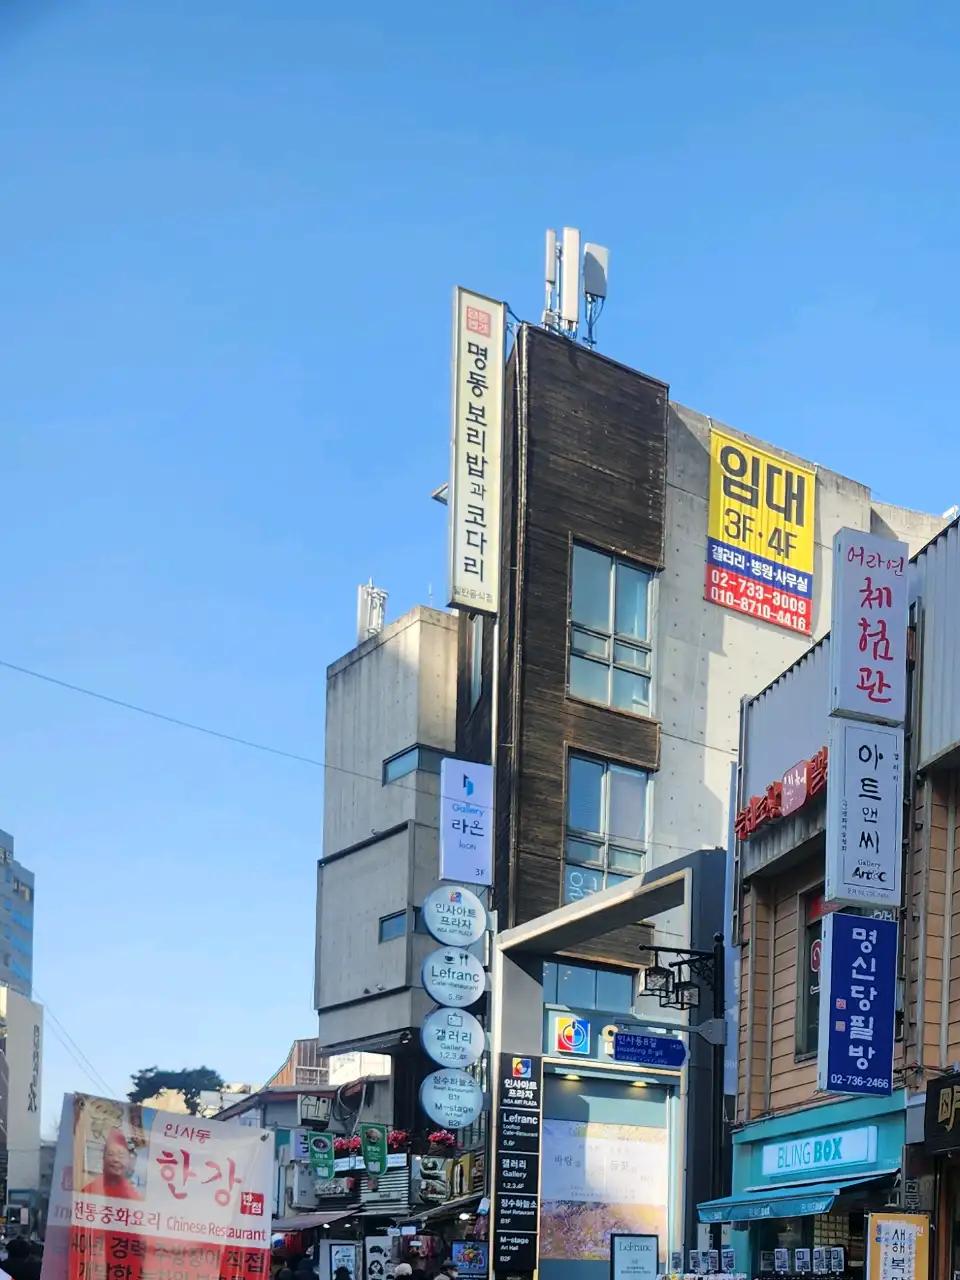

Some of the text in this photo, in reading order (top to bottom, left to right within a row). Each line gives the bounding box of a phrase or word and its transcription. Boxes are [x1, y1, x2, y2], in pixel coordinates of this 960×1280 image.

[720, 445, 805, 528] 임대
[711, 569, 806, 614] 02-733-3009
[711, 586, 806, 632] 010-8710-4416
[856, 577, 893, 703] 체험관
[452, 803, 485, 817] Gallery
[452, 818, 484, 837] 라온
[475, 868, 485, 876] 3F
[436, 903, 477, 918] 인사아트
[440, 916, 472, 929] 프라자
[431, 965, 480, 983] Lefranc
[848, 927, 877, 1070] 명신당필방
[436, 1029, 472, 1044] 갤러리
[440, 1042, 465, 1052] Gallery
[504, 1078, 538, 1090] 인사아트
[831, 1074, 889, 1089] 02-736-2466
[508, 1089, 533, 1099] 프라자
[503, 1112, 538, 1124] Lefranc
[165, 1123, 211, 1144] 인사동
[778, 1136, 843, 1168] BLING BOX
[502, 1159, 527, 1169] 갤러리
[156, 1149, 242, 1207] 한강
[502, 1170, 527, 1179] Gallery
[242, 1193, 263, 1215] 반점
[167, 1215, 266, 1241] Chinese Restaurant
[500, 1236, 529, 1244] M-stage
[227, 1250, 264, 1273] 직접
